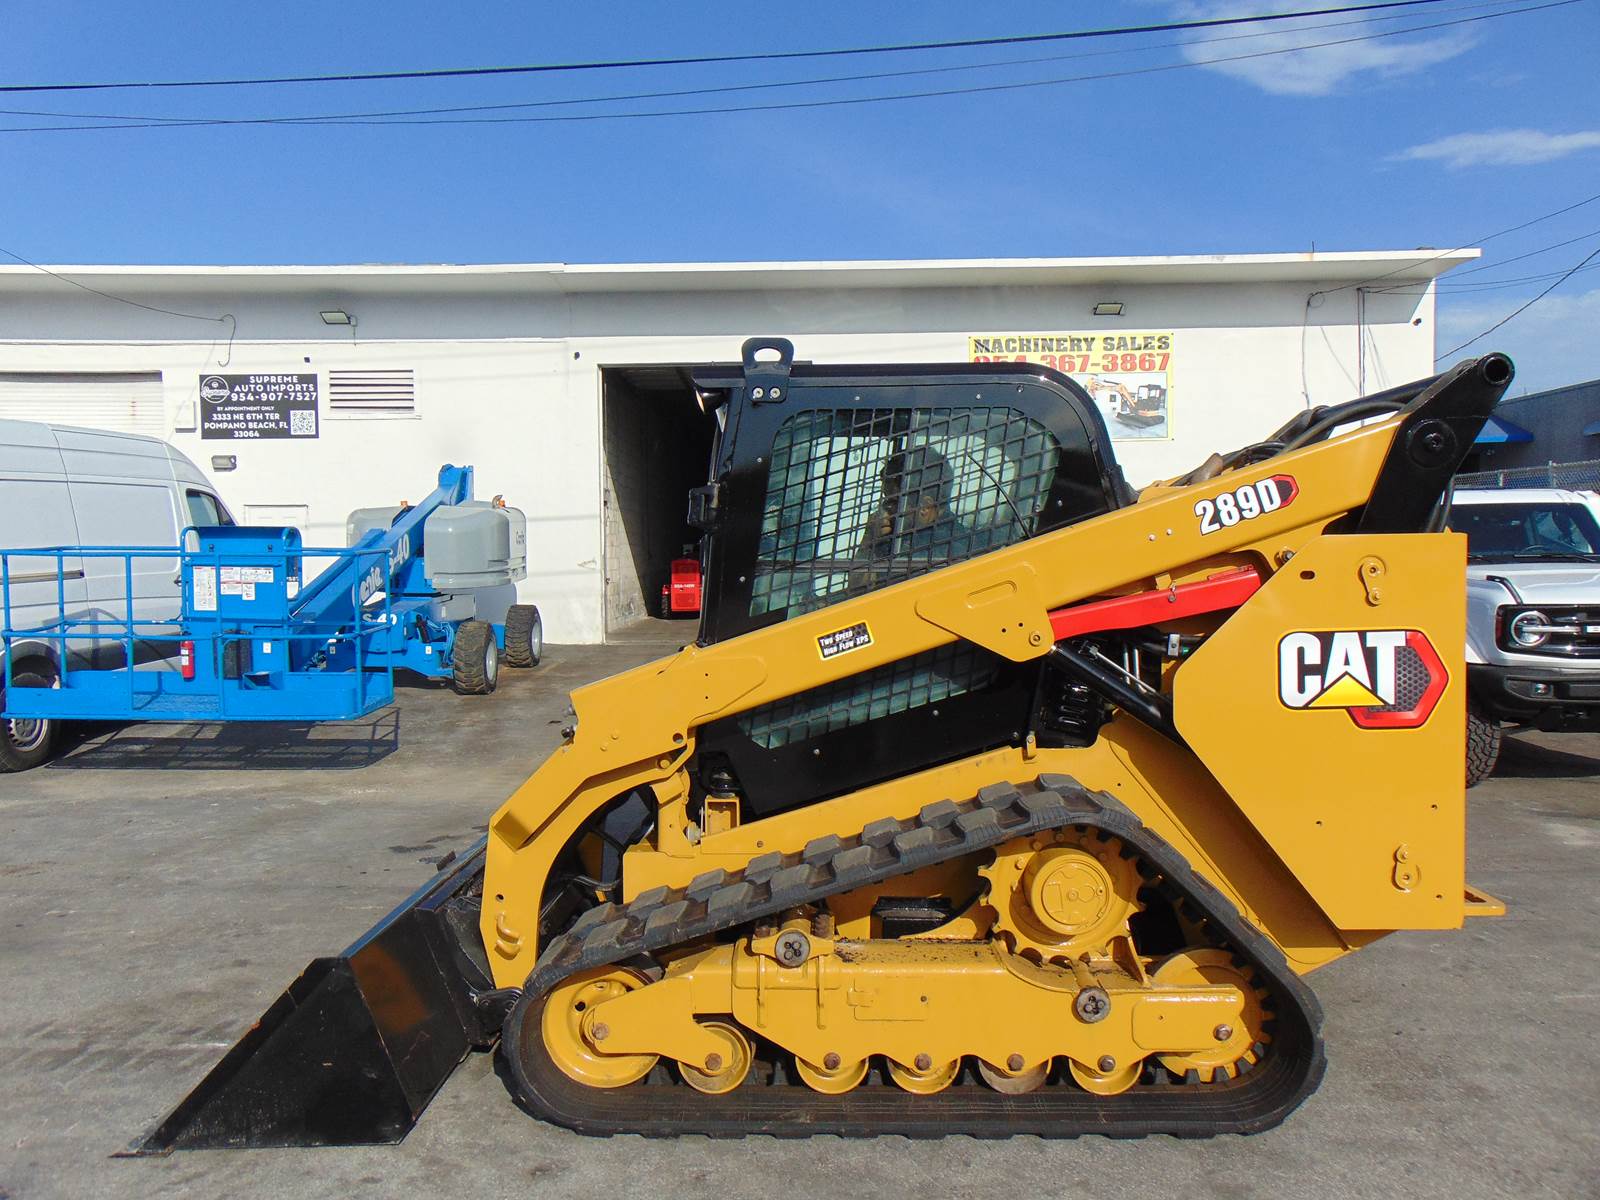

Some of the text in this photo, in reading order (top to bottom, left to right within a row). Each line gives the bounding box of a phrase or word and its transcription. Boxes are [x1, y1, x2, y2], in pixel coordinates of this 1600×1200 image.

[974, 335, 1170, 353] MACHINERY SALES
[249, 375, 299, 383] SUPREME
[234, 384, 264, 392] AUTO
[231, 392, 317, 401] 954-907-7527
[234, 430, 259, 438] 33064
[1194, 479, 1281, 535] 289D
[1280, 631, 1406, 707] CAT
